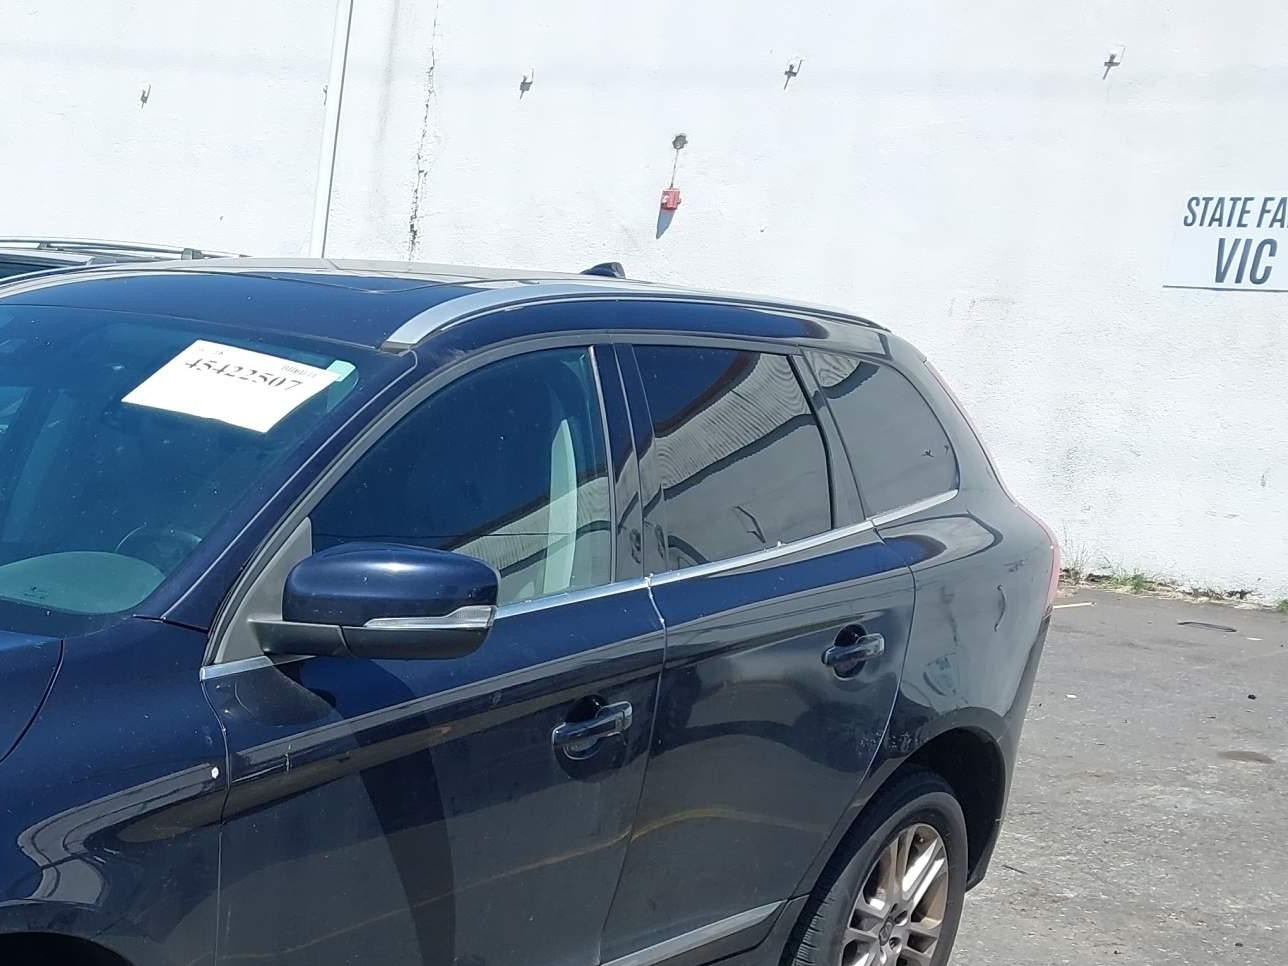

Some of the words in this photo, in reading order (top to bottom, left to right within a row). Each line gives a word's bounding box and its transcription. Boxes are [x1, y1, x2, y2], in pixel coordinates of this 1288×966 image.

[1184, 196, 1255, 228] STATE
[1256, 196, 1288, 229] FA
[1215, 237, 1278, 285] VIC
[185, 357, 304, 391] 45422507
